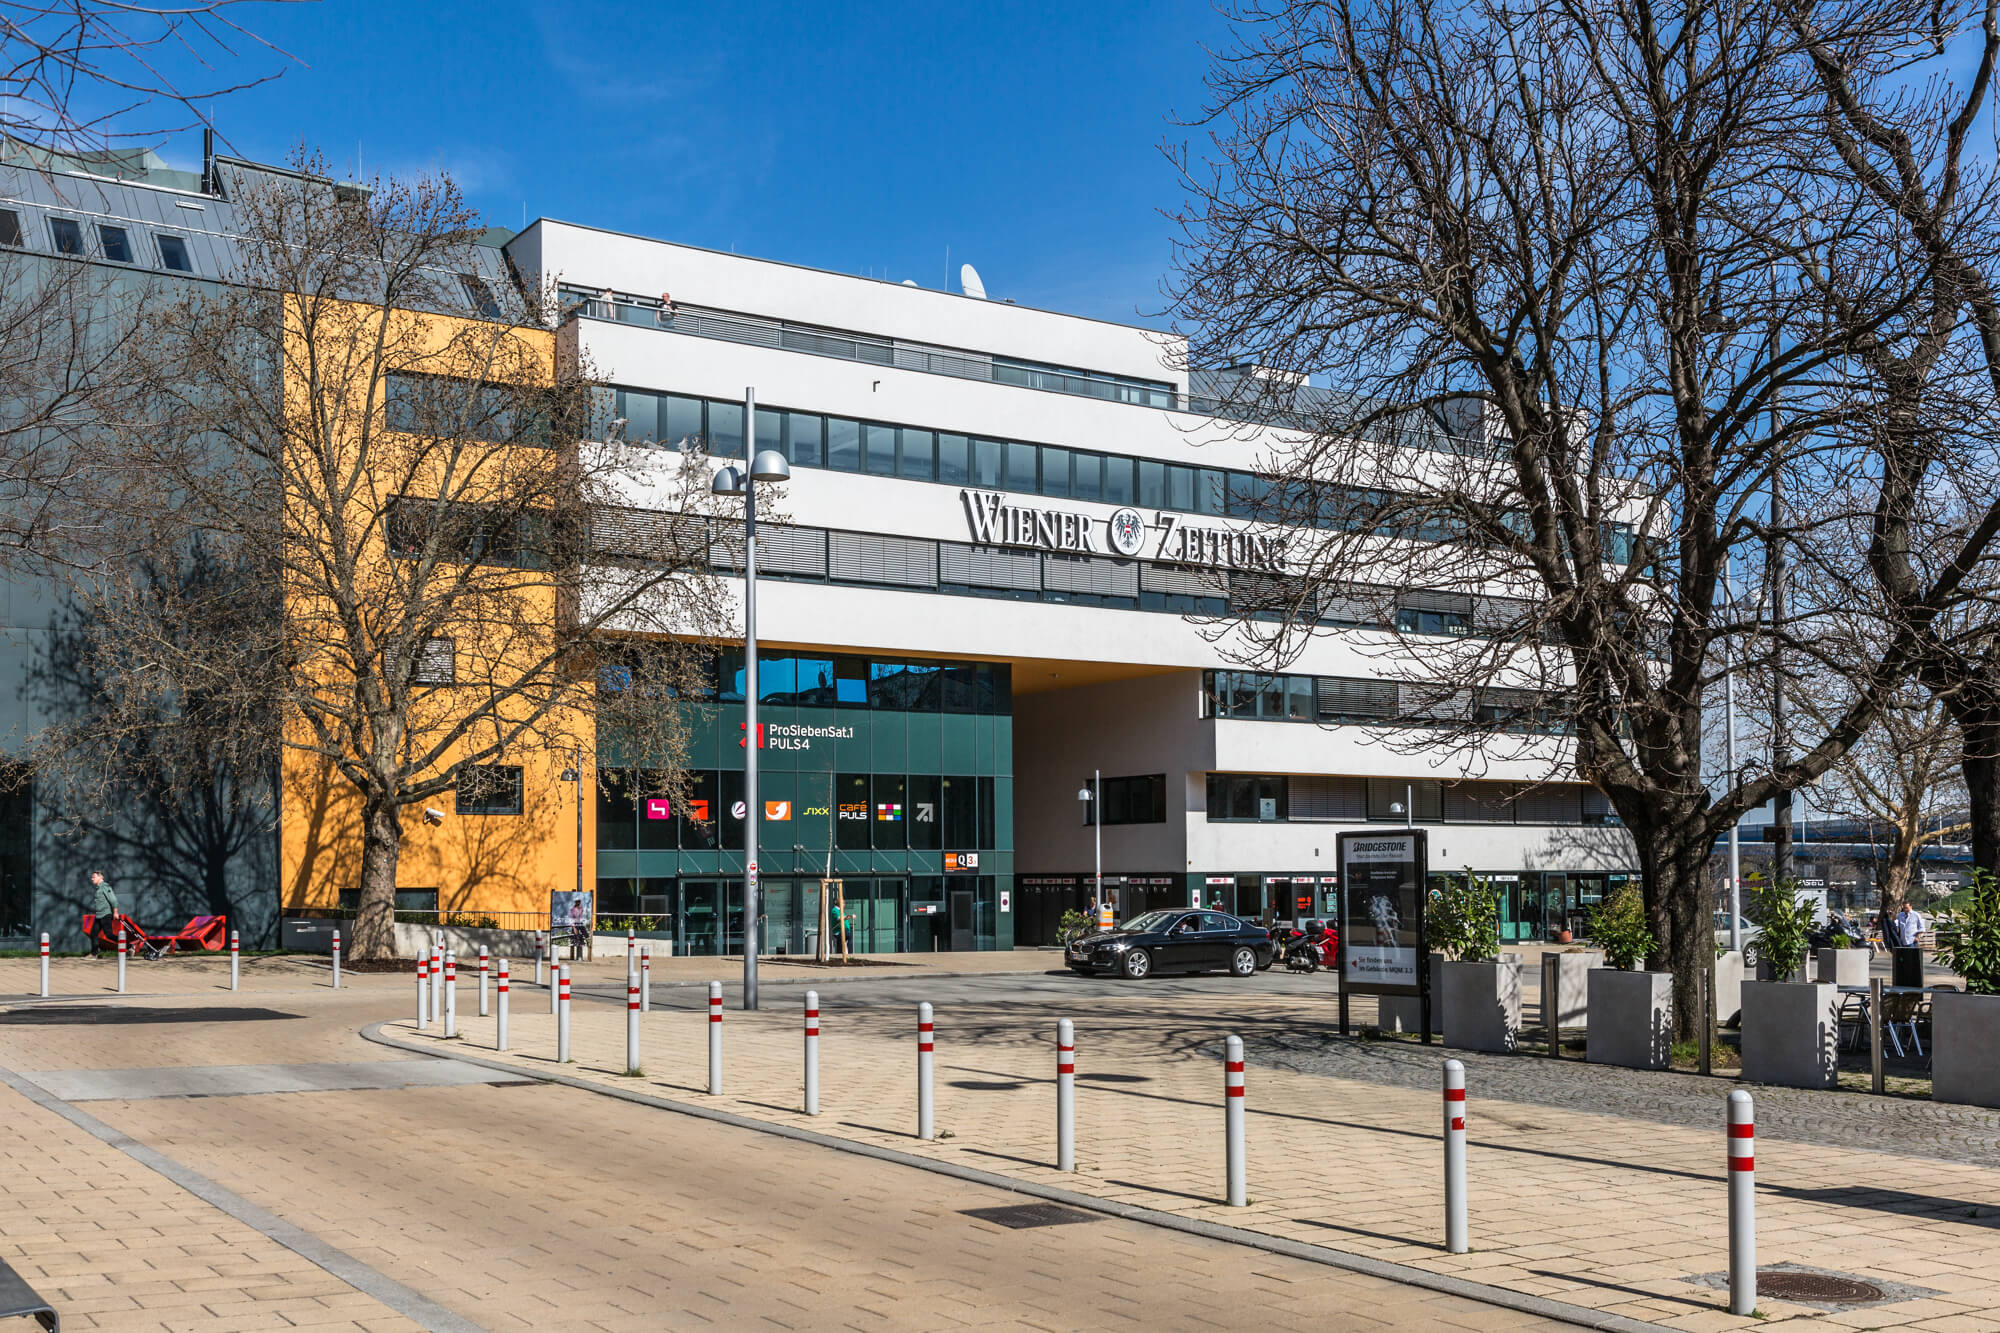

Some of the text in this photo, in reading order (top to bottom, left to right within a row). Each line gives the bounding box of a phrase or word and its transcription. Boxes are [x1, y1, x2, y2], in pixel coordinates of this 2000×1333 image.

[959, 489, 1289, 573] WIENER ZEITUNG
[769, 723, 854, 738] ProSiebenSat.1
[839, 811, 868, 820] PULS
[1353, 841, 1407, 852] BRIDGESTONE
[1366, 965, 1388, 973] Gebäue
